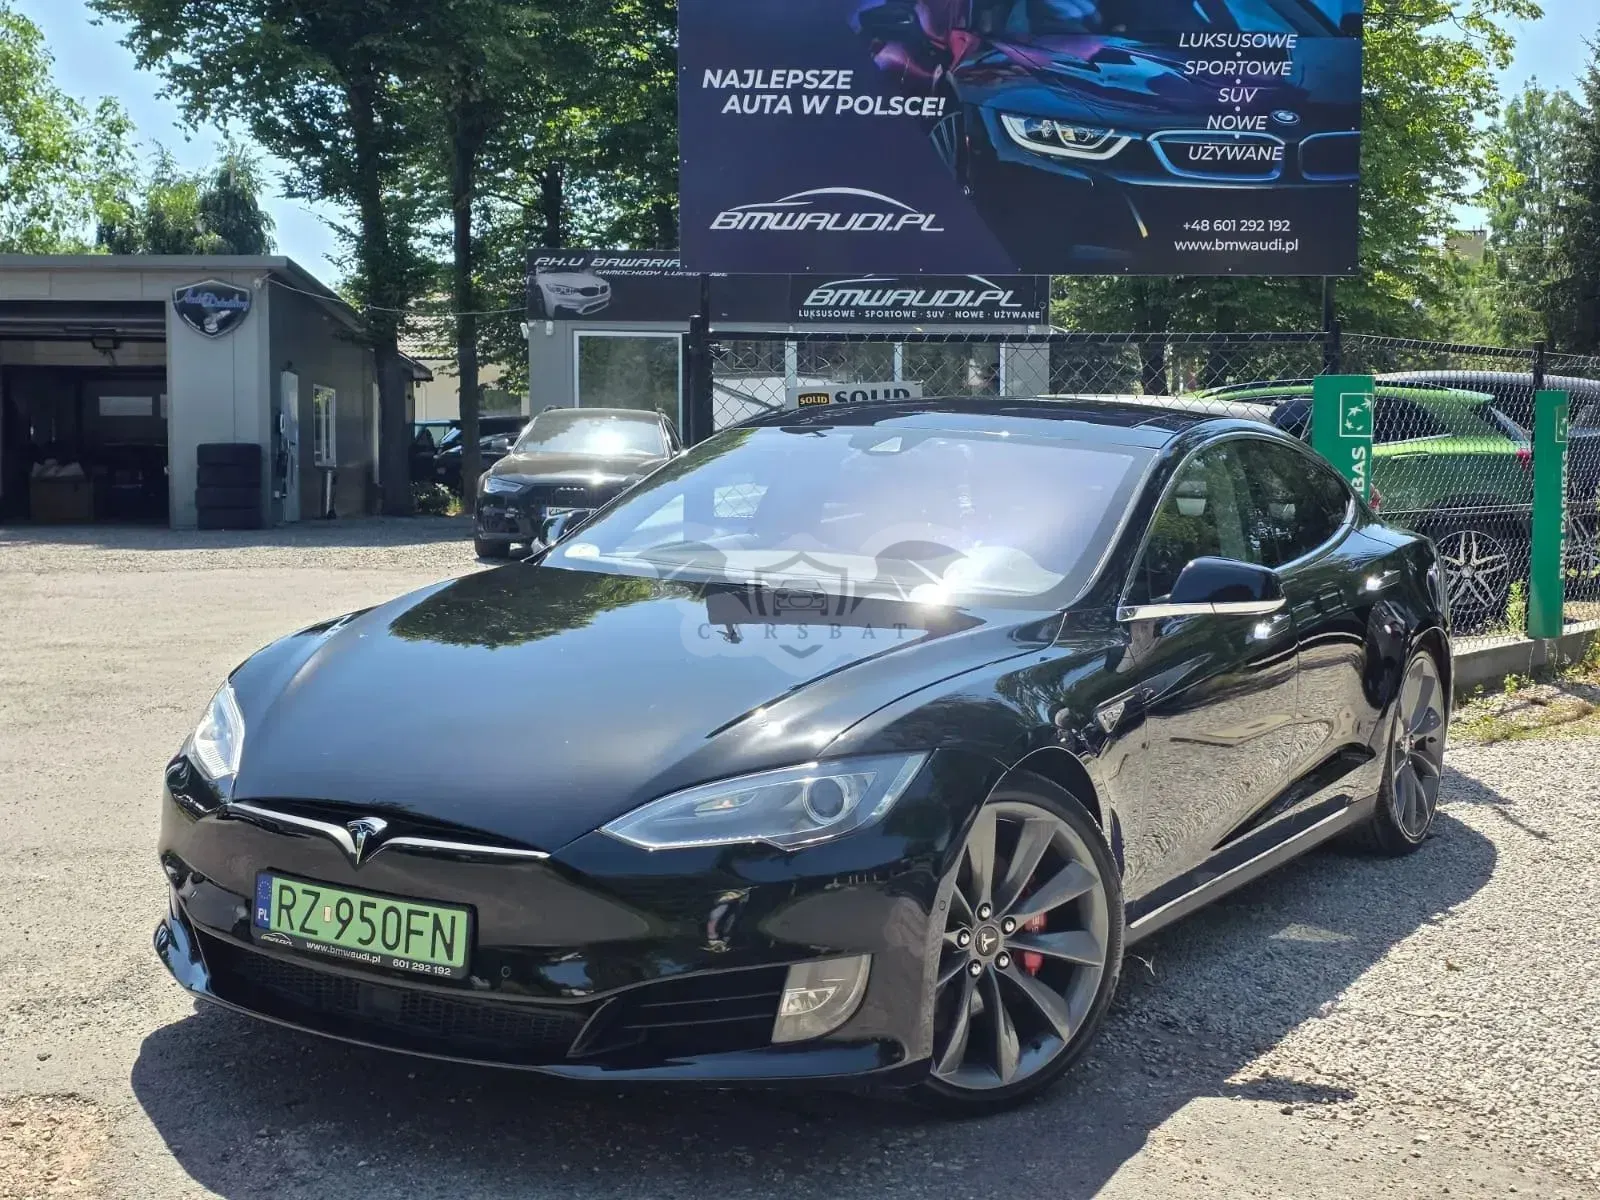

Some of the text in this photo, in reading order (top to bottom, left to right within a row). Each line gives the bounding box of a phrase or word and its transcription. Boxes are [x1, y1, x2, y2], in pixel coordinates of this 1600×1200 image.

[1179, 33, 1298, 49] LUKSUSOWE
[1183, 60, 1293, 76] SPORTOWE
[702, 69, 853, 89] NAJLEPSZE
[1218, 87, 1258, 103] SUV
[721, 95, 946, 117] AUTA W POLSCE!
[1206, 114, 1268, 130] NOWE
[1188, 142, 1285, 161] UŻYWANE
[709, 211, 945, 232] BMWAUDI.PL
[1183, 220, 1291, 232] +48 601 292 192
[1174, 238, 1299, 253] www.bmwaudi.pl
[590, 258, 680, 267] BAWARIA
[803, 289, 1022, 307] BMWAUDI.PL
[798, 309, 1040, 319] LUKSUSOWE SPORTOWE SUV NOWE UŻYWANE
[799, 396, 828, 405] SOLID
[257, 907, 269, 922] PL
[277, 884, 456, 962] RZ 950FN
[306, 941, 451, 976] www.bmwaudi.pl 601 292 192
